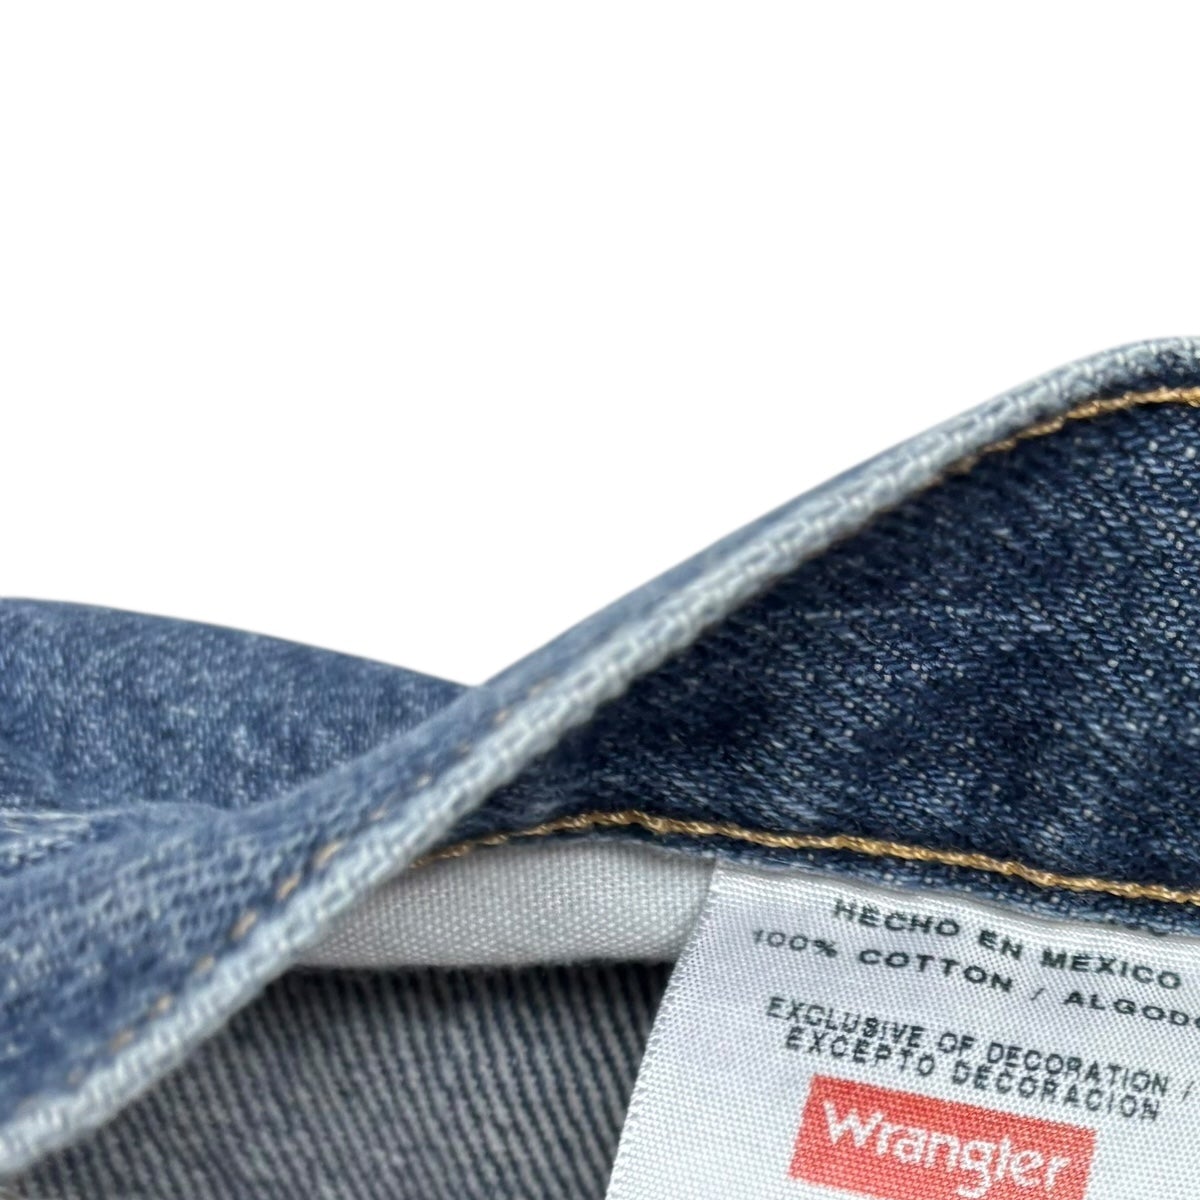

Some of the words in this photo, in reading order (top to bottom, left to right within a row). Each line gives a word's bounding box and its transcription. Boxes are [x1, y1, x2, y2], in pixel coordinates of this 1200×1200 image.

[753, 929, 838, 957] 100%
[858, 949, 1013, 992] COTTON
[1031, 987, 1045, 1001] /
[833, 899, 960, 937] HECHO
[978, 929, 1023, 960] EN
[1040, 948, 1182, 989] MEXICO
[766, 996, 925, 1048] EXCLUSIVE
[938, 1032, 975, 1057] OF
[986, 1041, 1169, 1097] DECORATION
[1182, 1080, 1195, 1102] /
[785, 1025, 936, 1077] EXCEPTO
[951, 1059, 1160, 1122] DECORACION
[821, 1099, 1073, 1200] Wrangler
